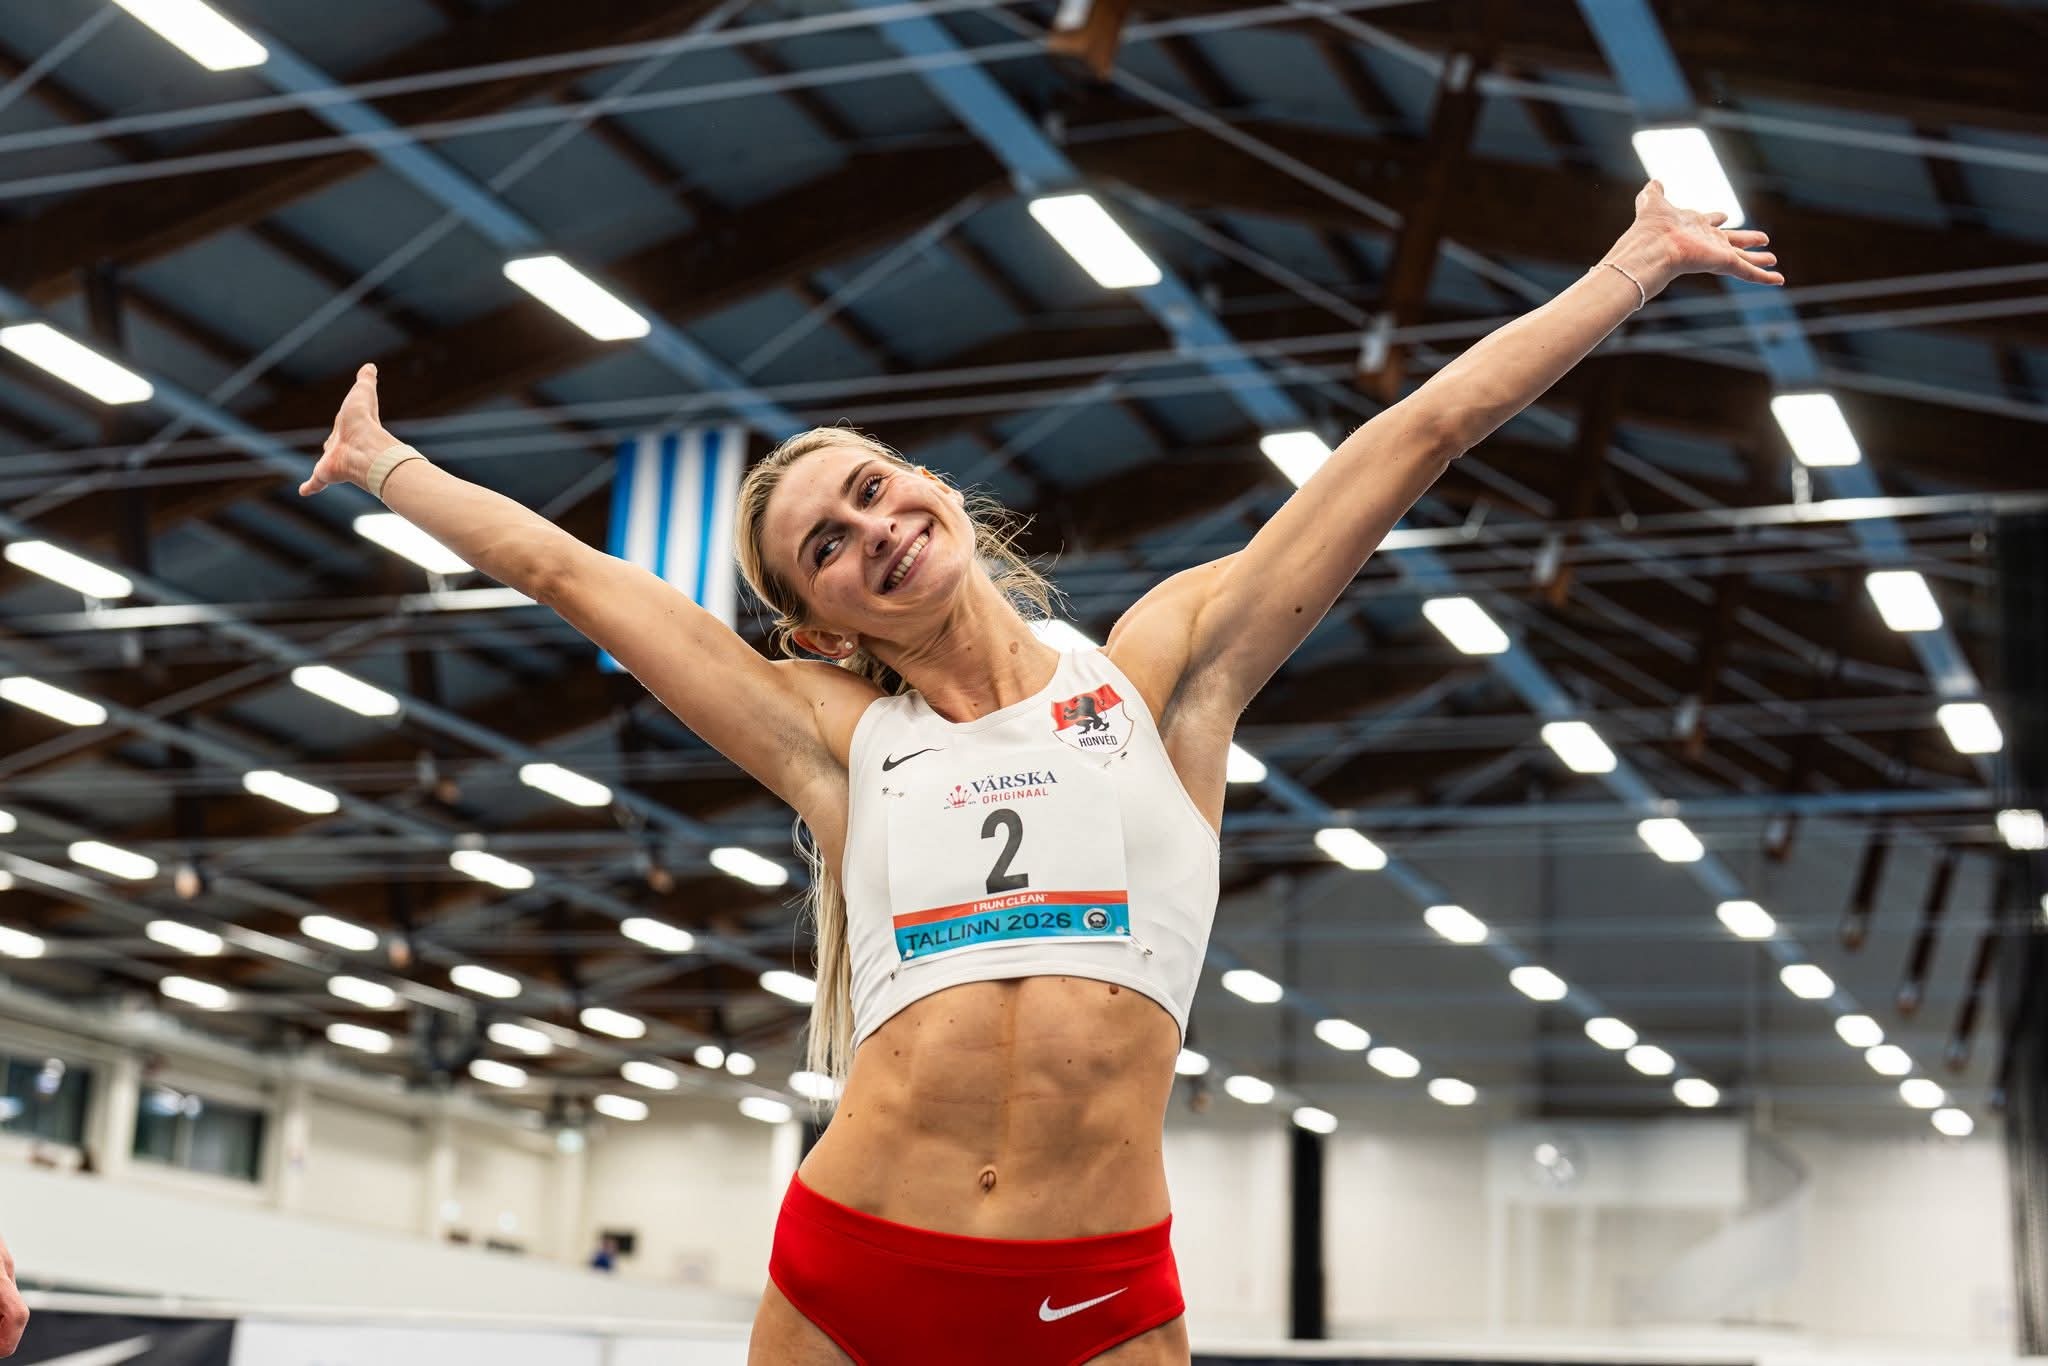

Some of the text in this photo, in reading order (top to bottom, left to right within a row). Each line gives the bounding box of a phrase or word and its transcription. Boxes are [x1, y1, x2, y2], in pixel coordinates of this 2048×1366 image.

[1079, 733, 1118, 747] HONVÉD
[971, 771, 1057, 793] VÄRSKA
[982, 788, 1048, 804] ORIGINAAL
[981, 808, 1029, 894] 2
[973, 903, 978, 913] I
[979, 899, 1004, 911] RUN
[905, 913, 1072, 950] TALLINN 2026
